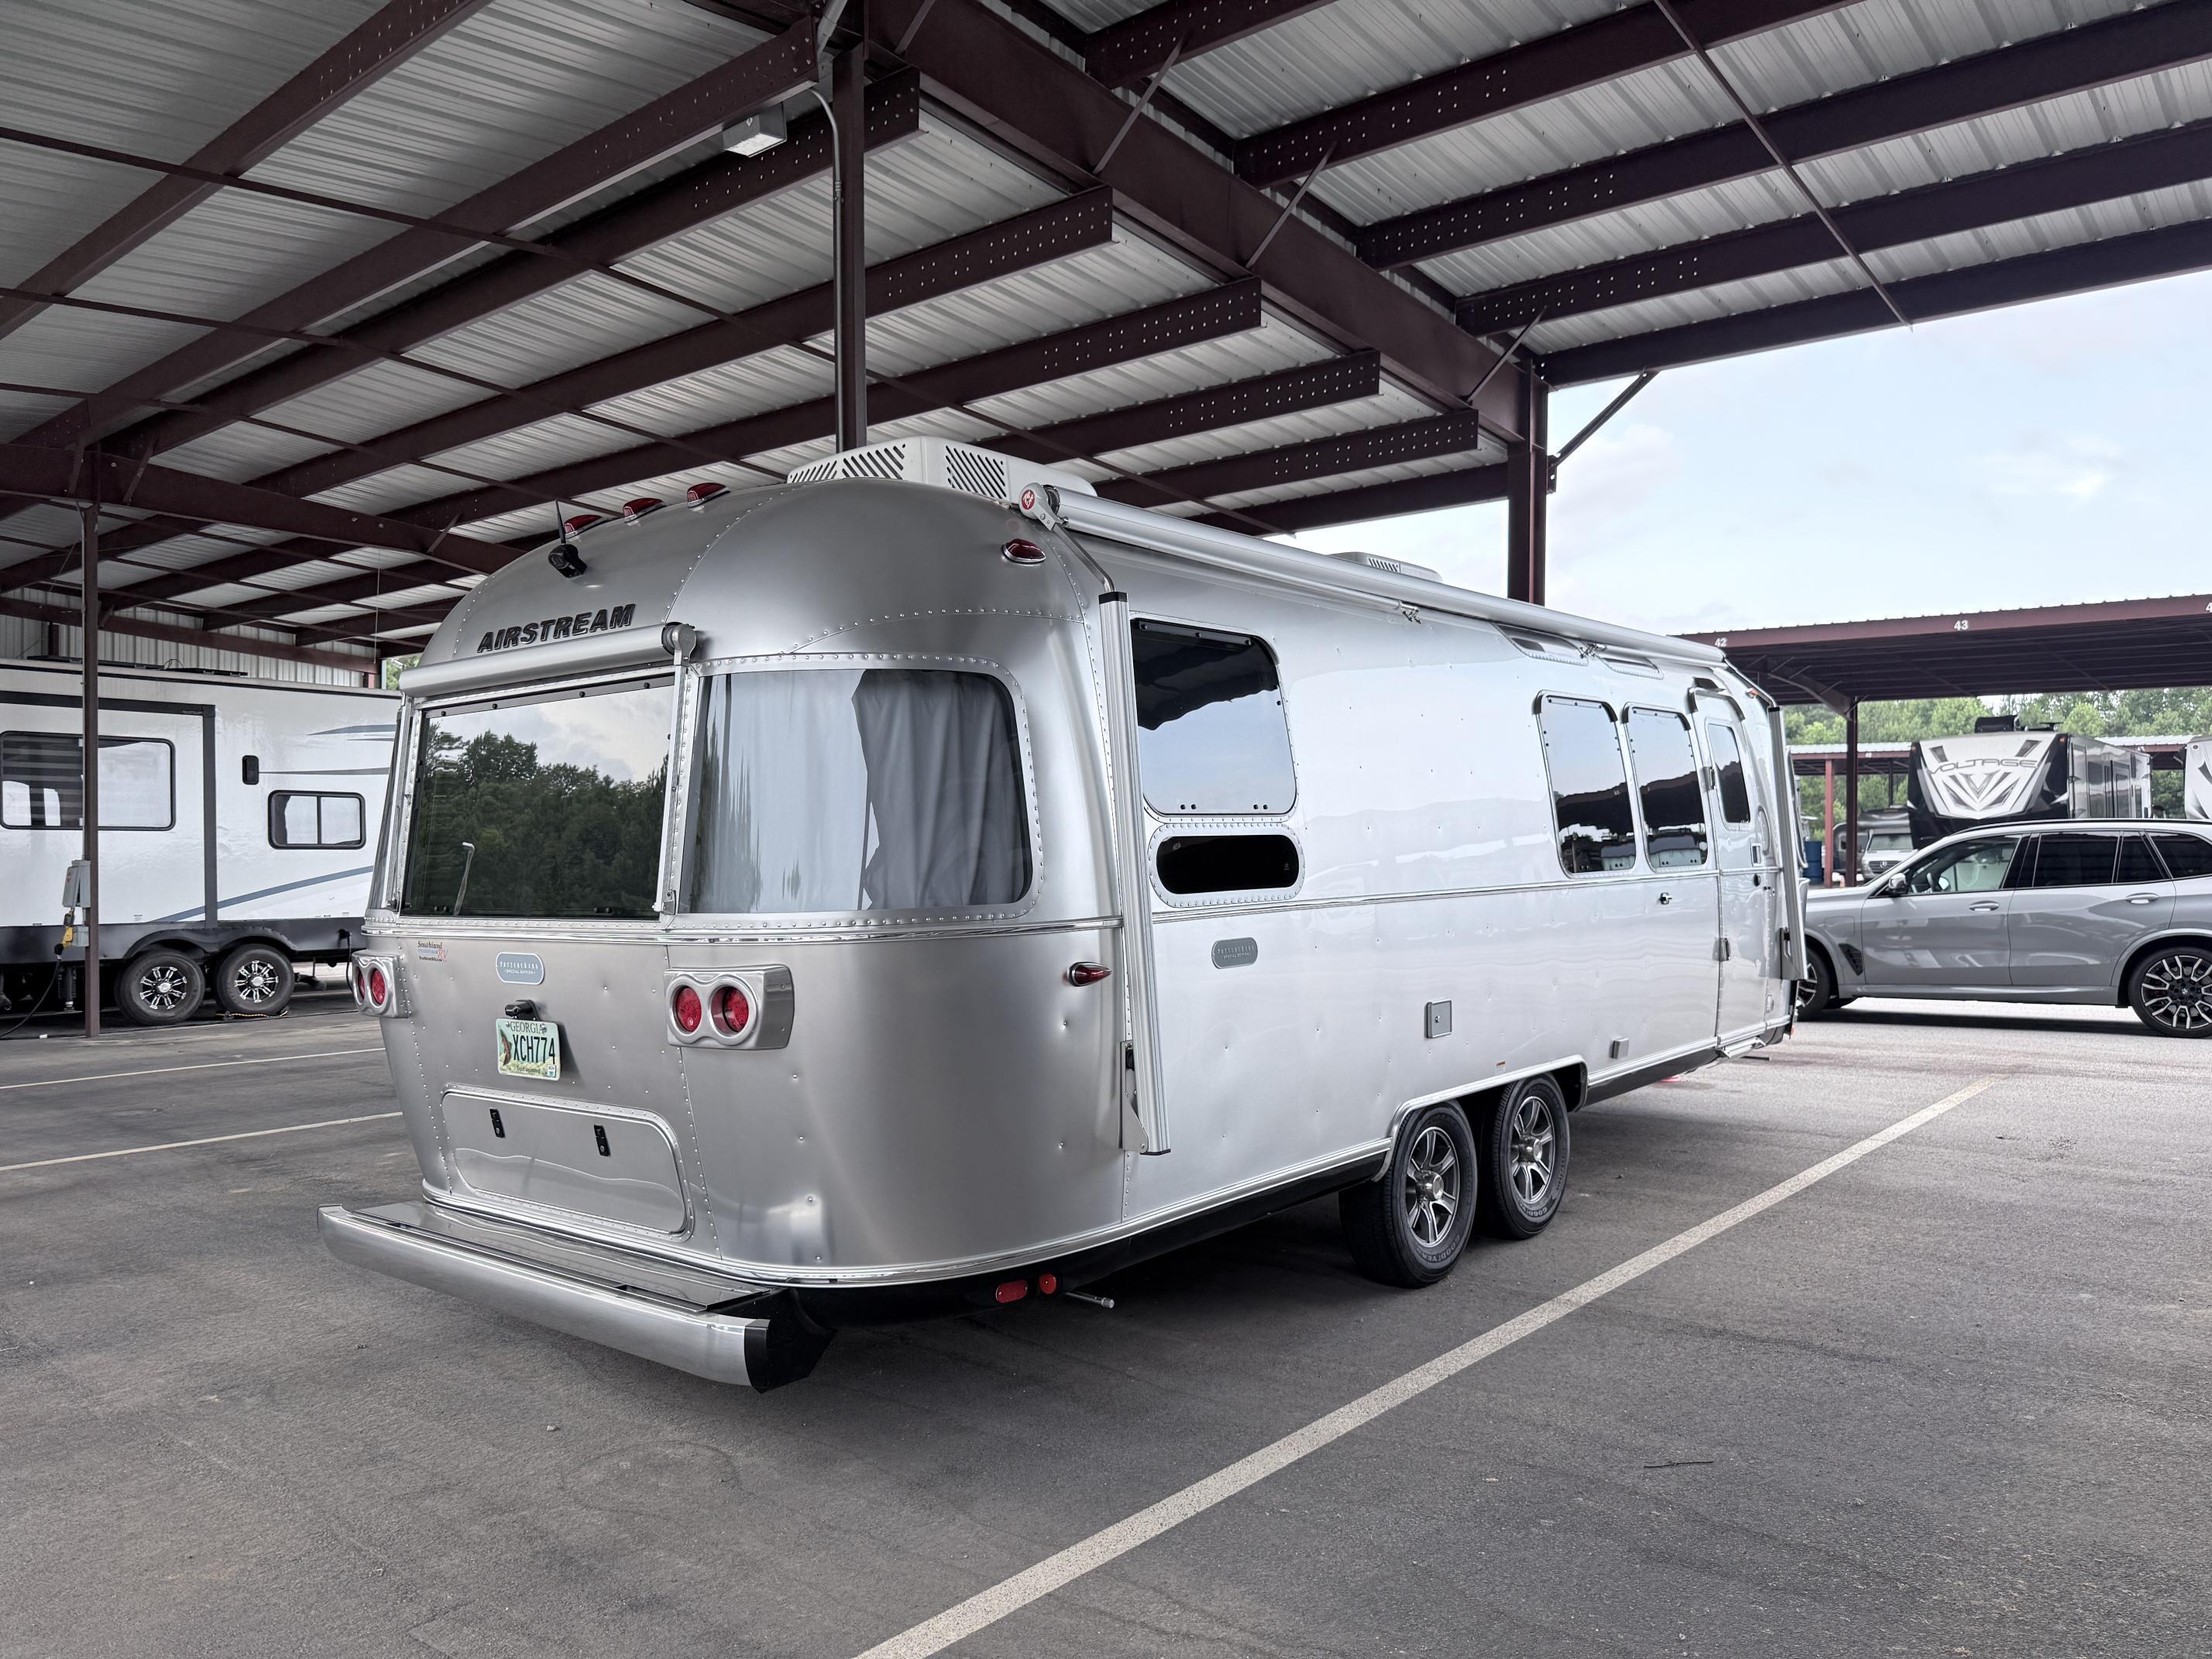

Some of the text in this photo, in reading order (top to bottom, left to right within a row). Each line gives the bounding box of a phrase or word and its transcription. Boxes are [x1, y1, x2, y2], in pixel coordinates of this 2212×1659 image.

[477, 603, 636, 653] AIRSTREAM
[1953, 619, 1969, 631] 43
[1714, 637, 1727, 647] 42
[1926, 758, 2039, 775] VOLTAGE
[512, 1034, 555, 1064] XCH774
